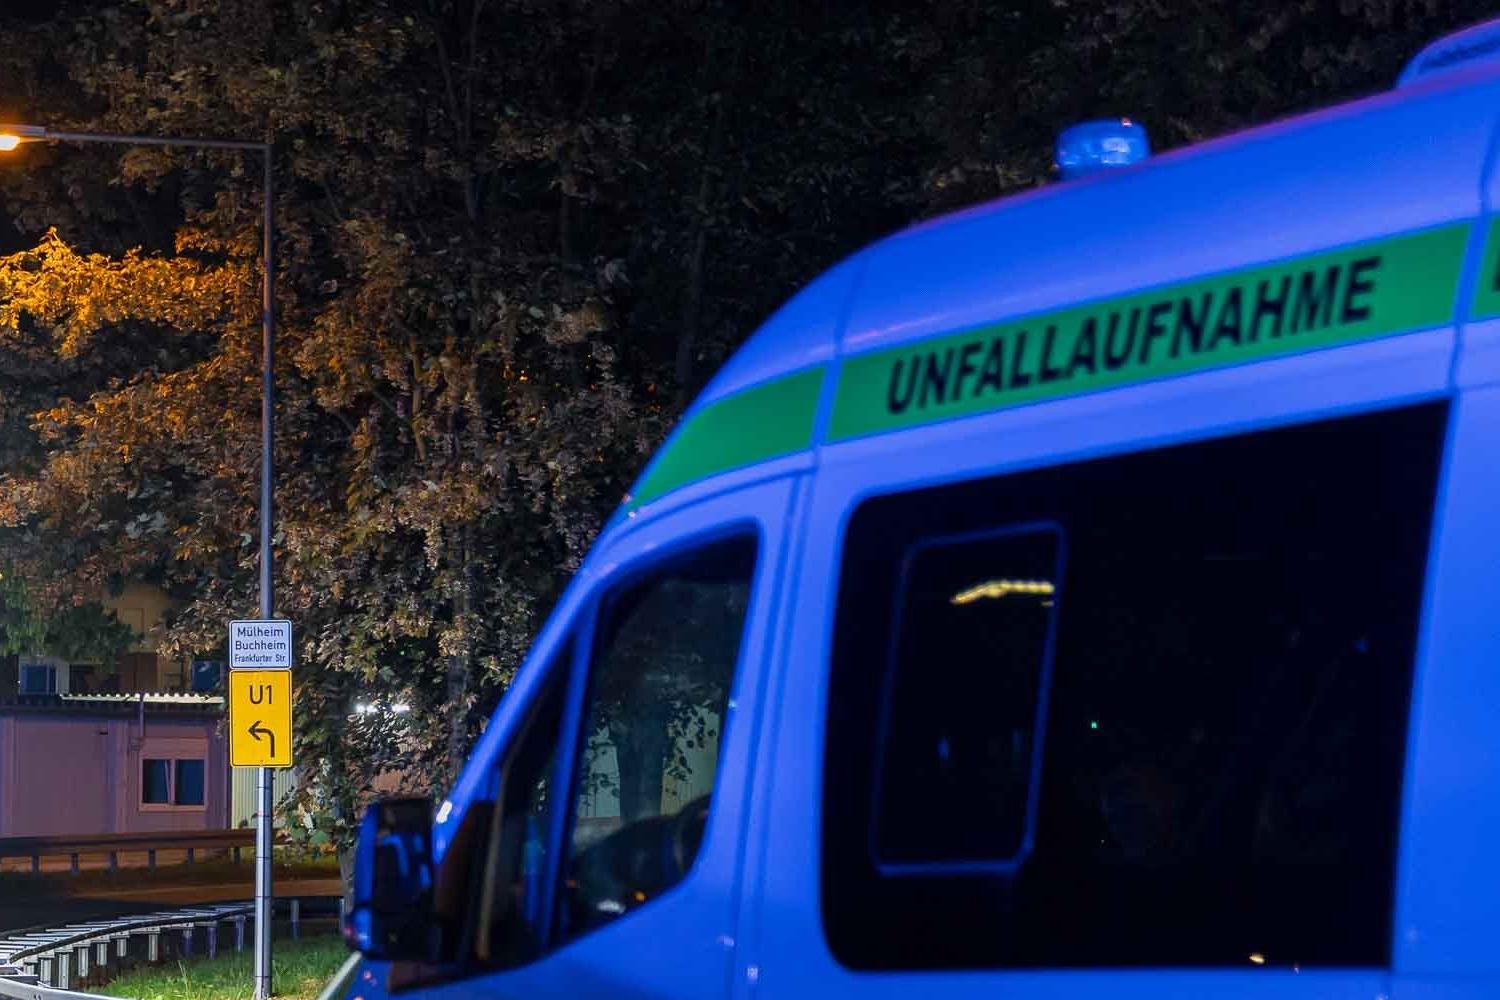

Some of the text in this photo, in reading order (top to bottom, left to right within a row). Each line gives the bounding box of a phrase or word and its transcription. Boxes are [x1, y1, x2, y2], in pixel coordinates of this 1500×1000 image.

[886, 255, 1382, 415] UNFALLAUFNAHME
[237, 626, 284, 637] Mülheim
[235, 640, 286, 651] Buchheim
[234, 653, 273, 663] Frankfurter
[249, 684, 273, 705] U1
